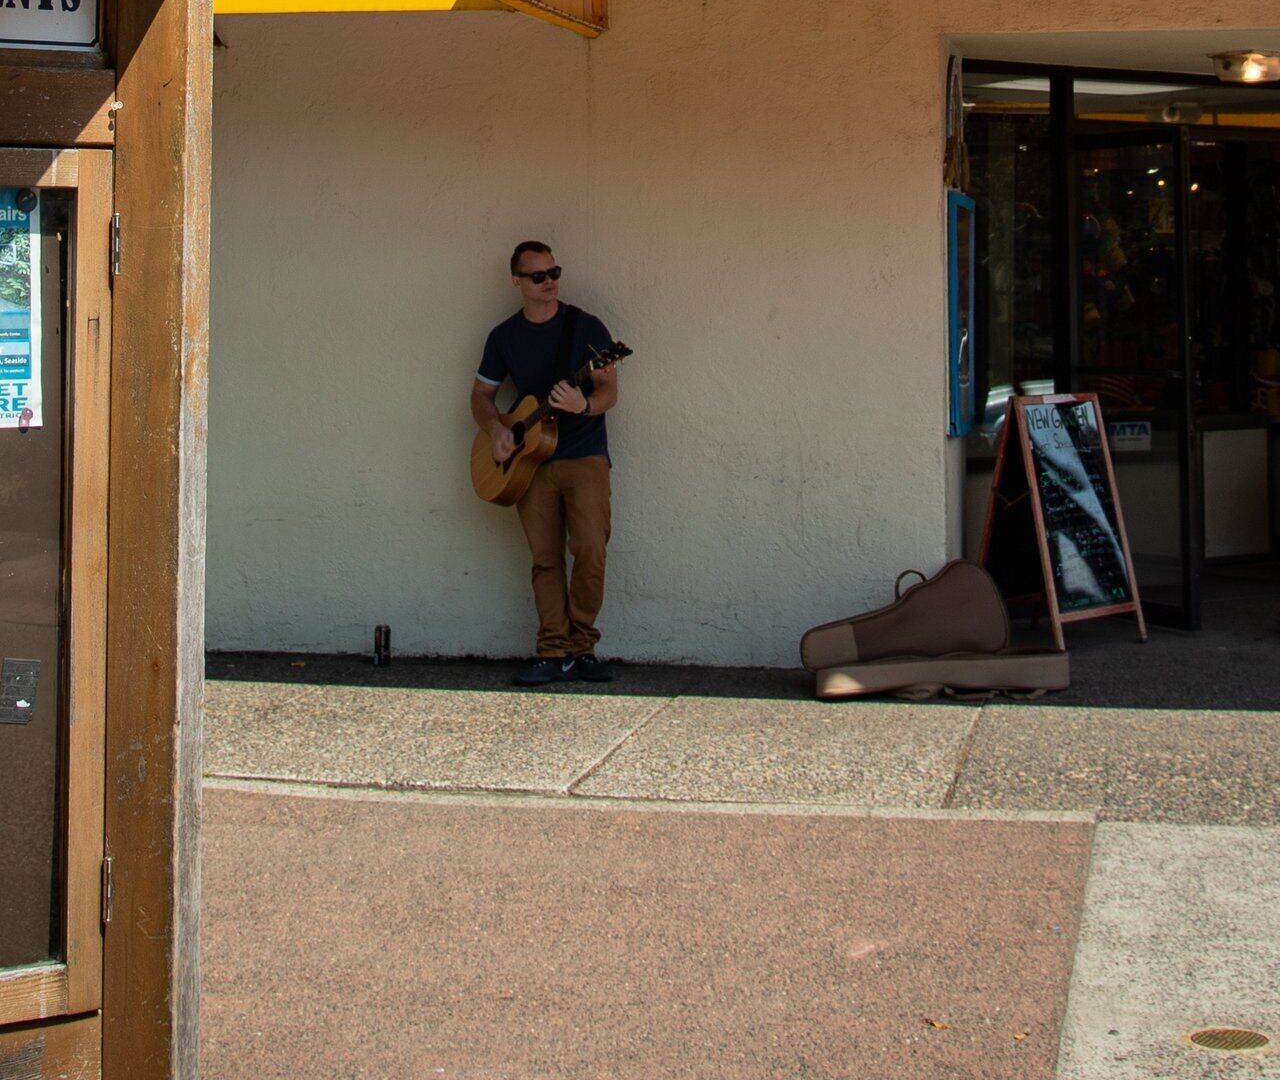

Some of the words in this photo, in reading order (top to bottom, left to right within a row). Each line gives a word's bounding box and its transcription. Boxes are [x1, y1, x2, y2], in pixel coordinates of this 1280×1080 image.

[4, 357, 28, 365] Seaside
[1026, 407, 1050, 431] NEW
[1110, 423, 1150, 436] MTA
